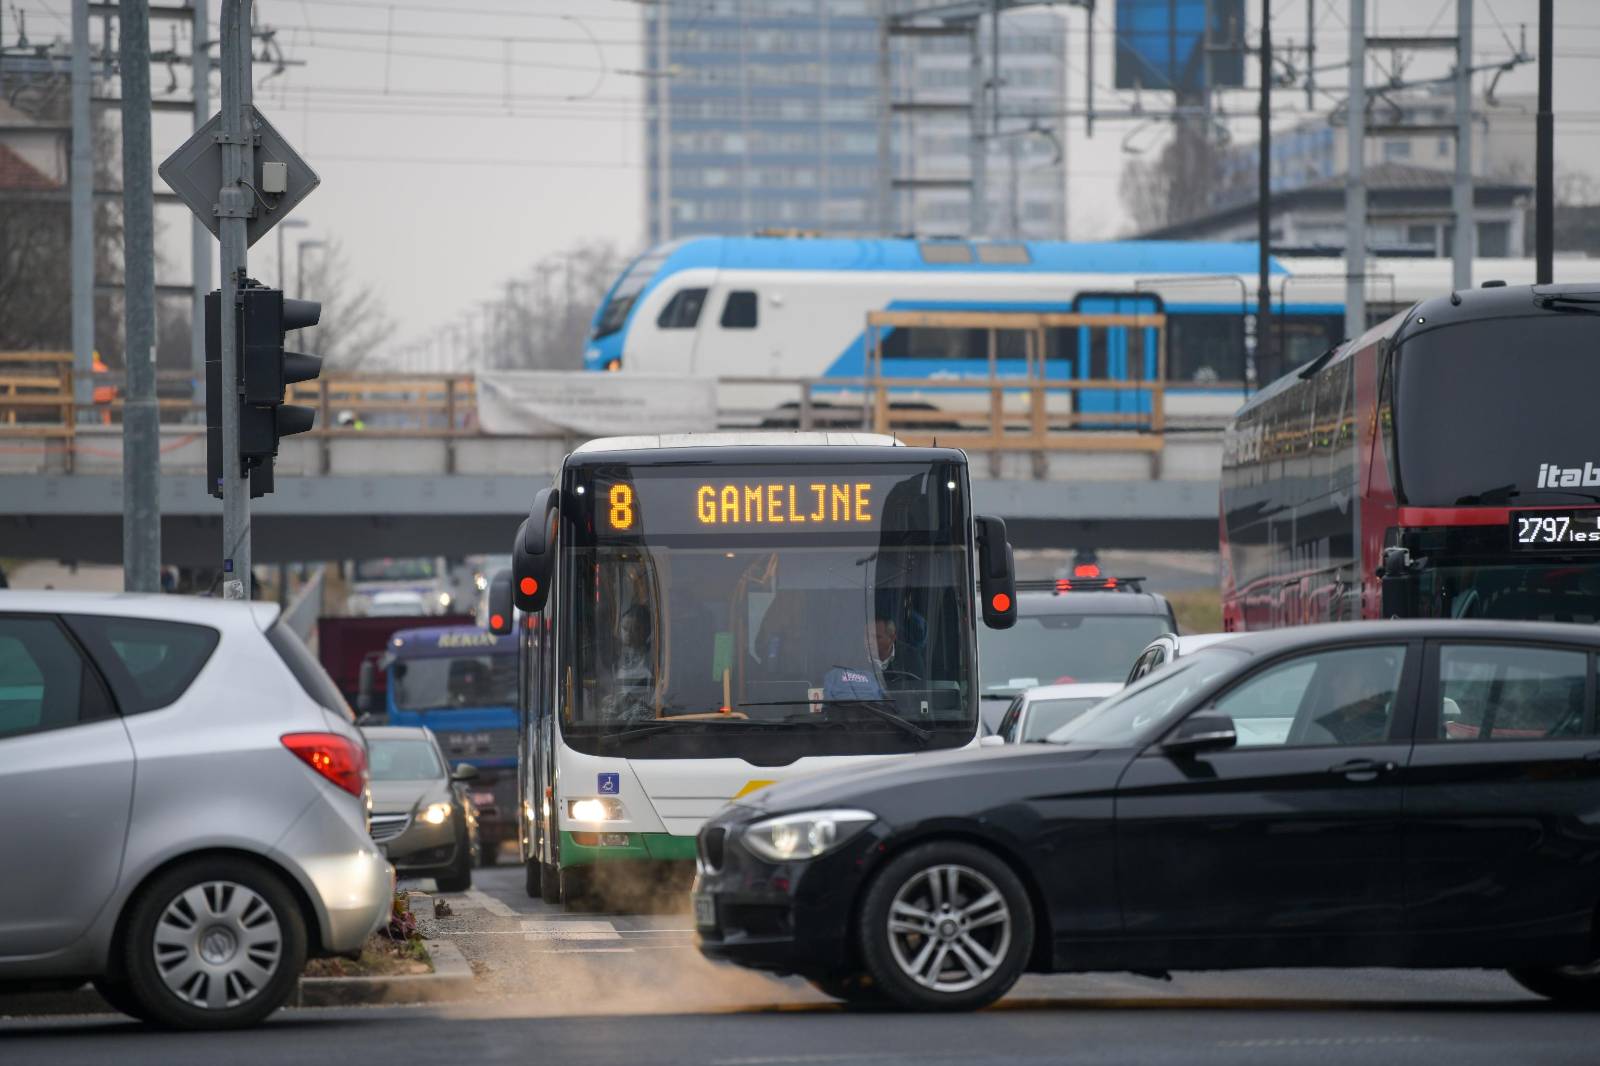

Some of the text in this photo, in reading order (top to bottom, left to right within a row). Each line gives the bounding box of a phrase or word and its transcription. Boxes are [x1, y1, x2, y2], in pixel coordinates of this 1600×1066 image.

[610, 483, 871, 529] 8 GAMELJNE
[1518, 517, 1570, 542] 2797
